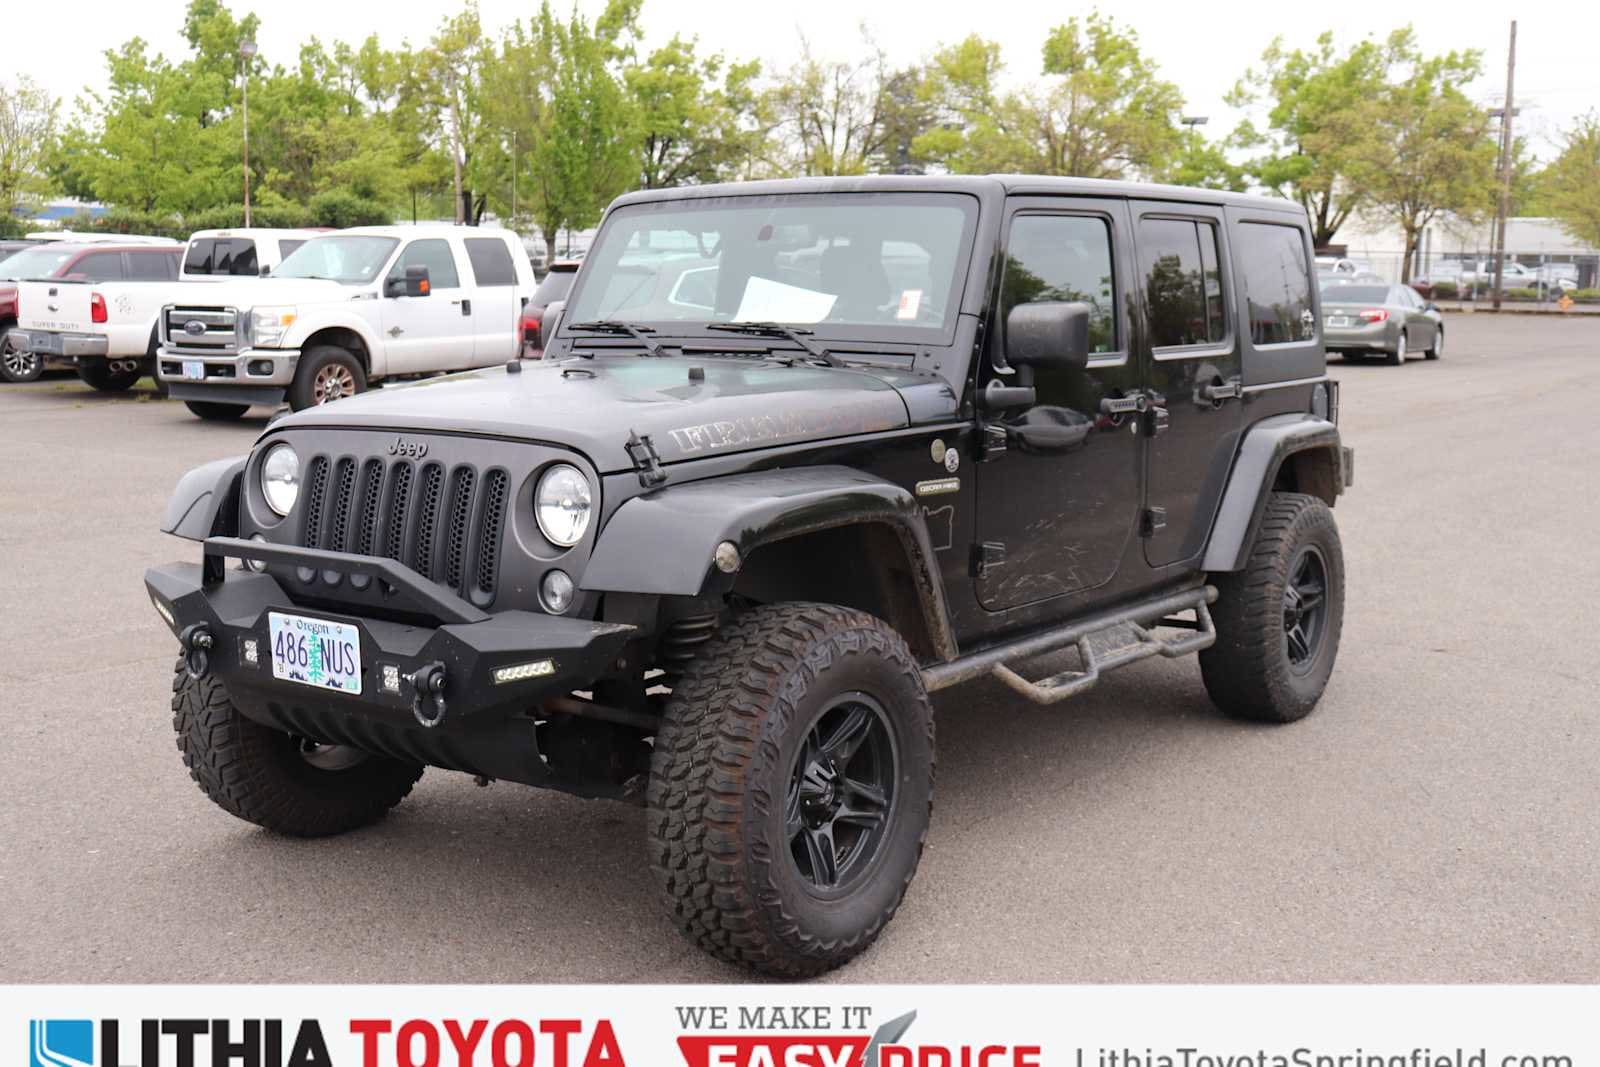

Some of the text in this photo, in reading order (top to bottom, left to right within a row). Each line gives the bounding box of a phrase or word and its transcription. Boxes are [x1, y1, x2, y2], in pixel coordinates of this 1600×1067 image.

[32, 321, 80, 330] SUPER DUTY
[387, 437, 429, 461] Jeep
[296, 619, 330, 635] Oregon
[275, 630, 355, 676] 486 NUS
